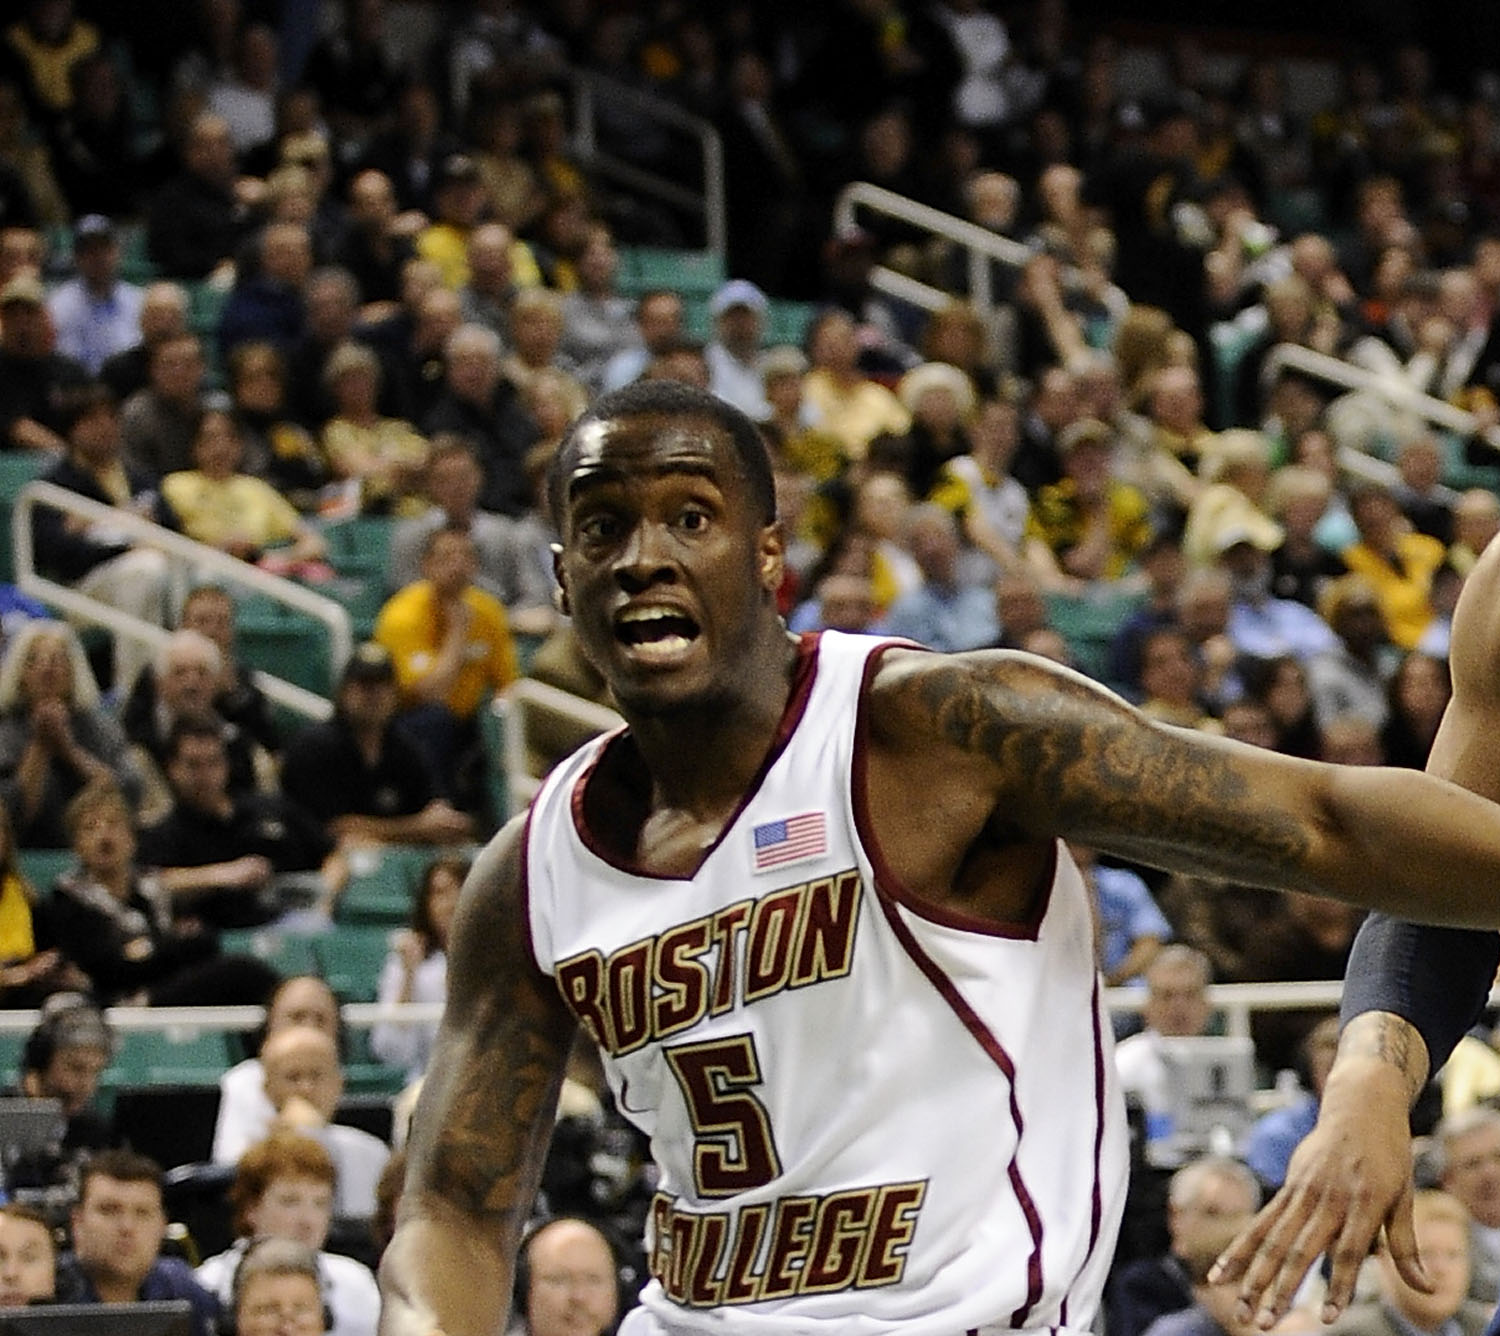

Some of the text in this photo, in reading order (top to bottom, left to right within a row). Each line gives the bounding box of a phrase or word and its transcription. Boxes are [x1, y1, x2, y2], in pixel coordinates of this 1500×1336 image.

[554, 867, 864, 1060] BOSTON
[661, 1032, 783, 1200] 5
[648, 1178, 930, 1309] COLLEGE
